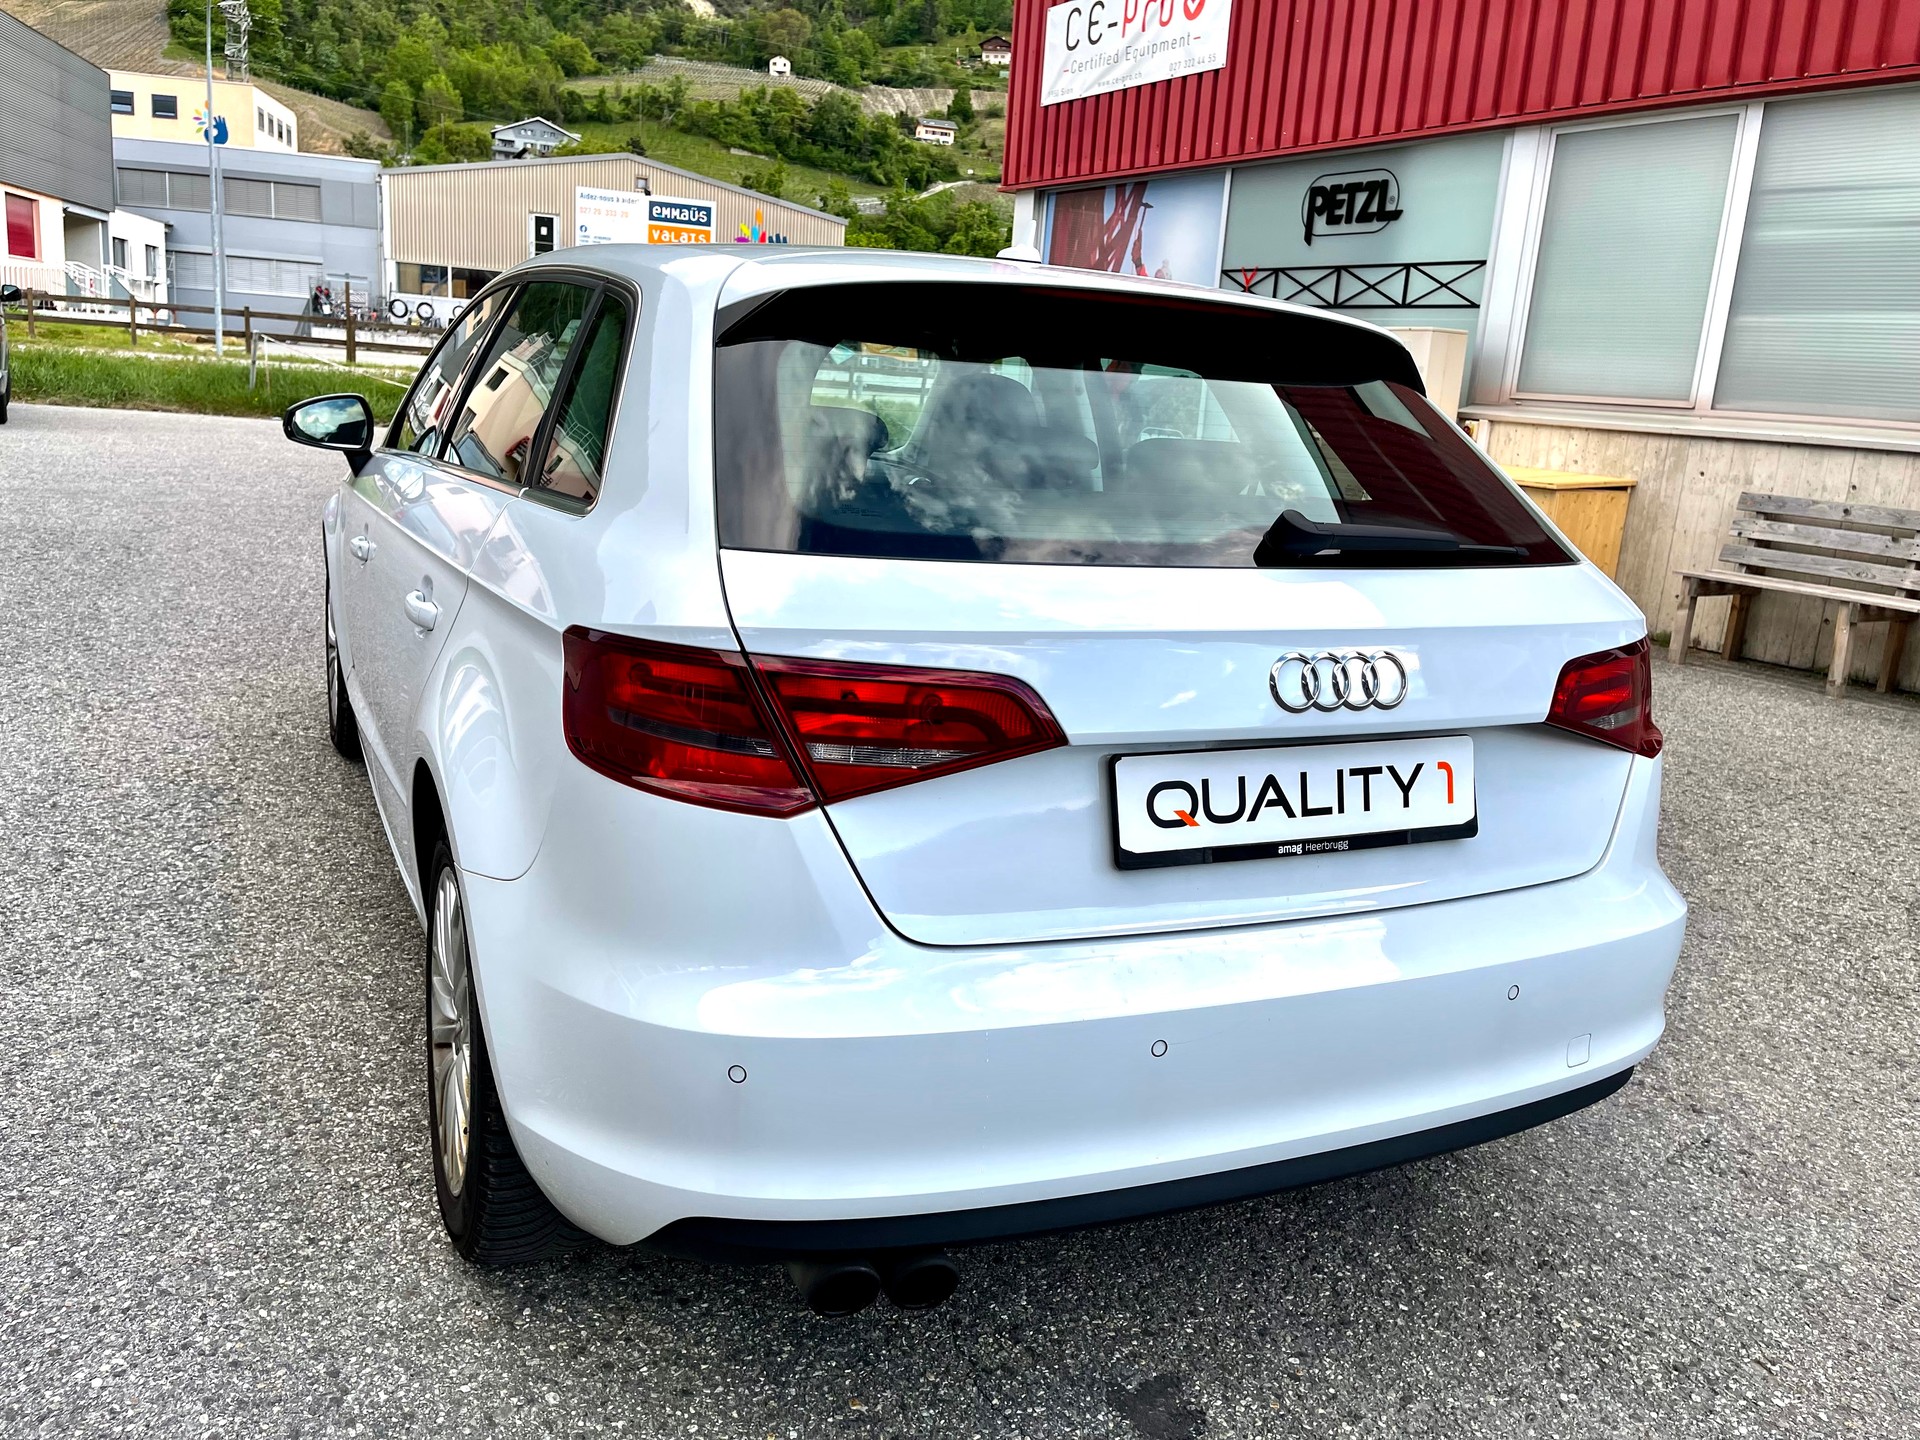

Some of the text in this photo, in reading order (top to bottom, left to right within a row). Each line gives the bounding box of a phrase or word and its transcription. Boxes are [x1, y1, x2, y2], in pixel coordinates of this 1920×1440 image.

[1303, 179, 1404, 246] PETZL
[1146, 761, 1455, 829] QUALITY 1
[1278, 840, 1349, 855] amag Heerbrugg
